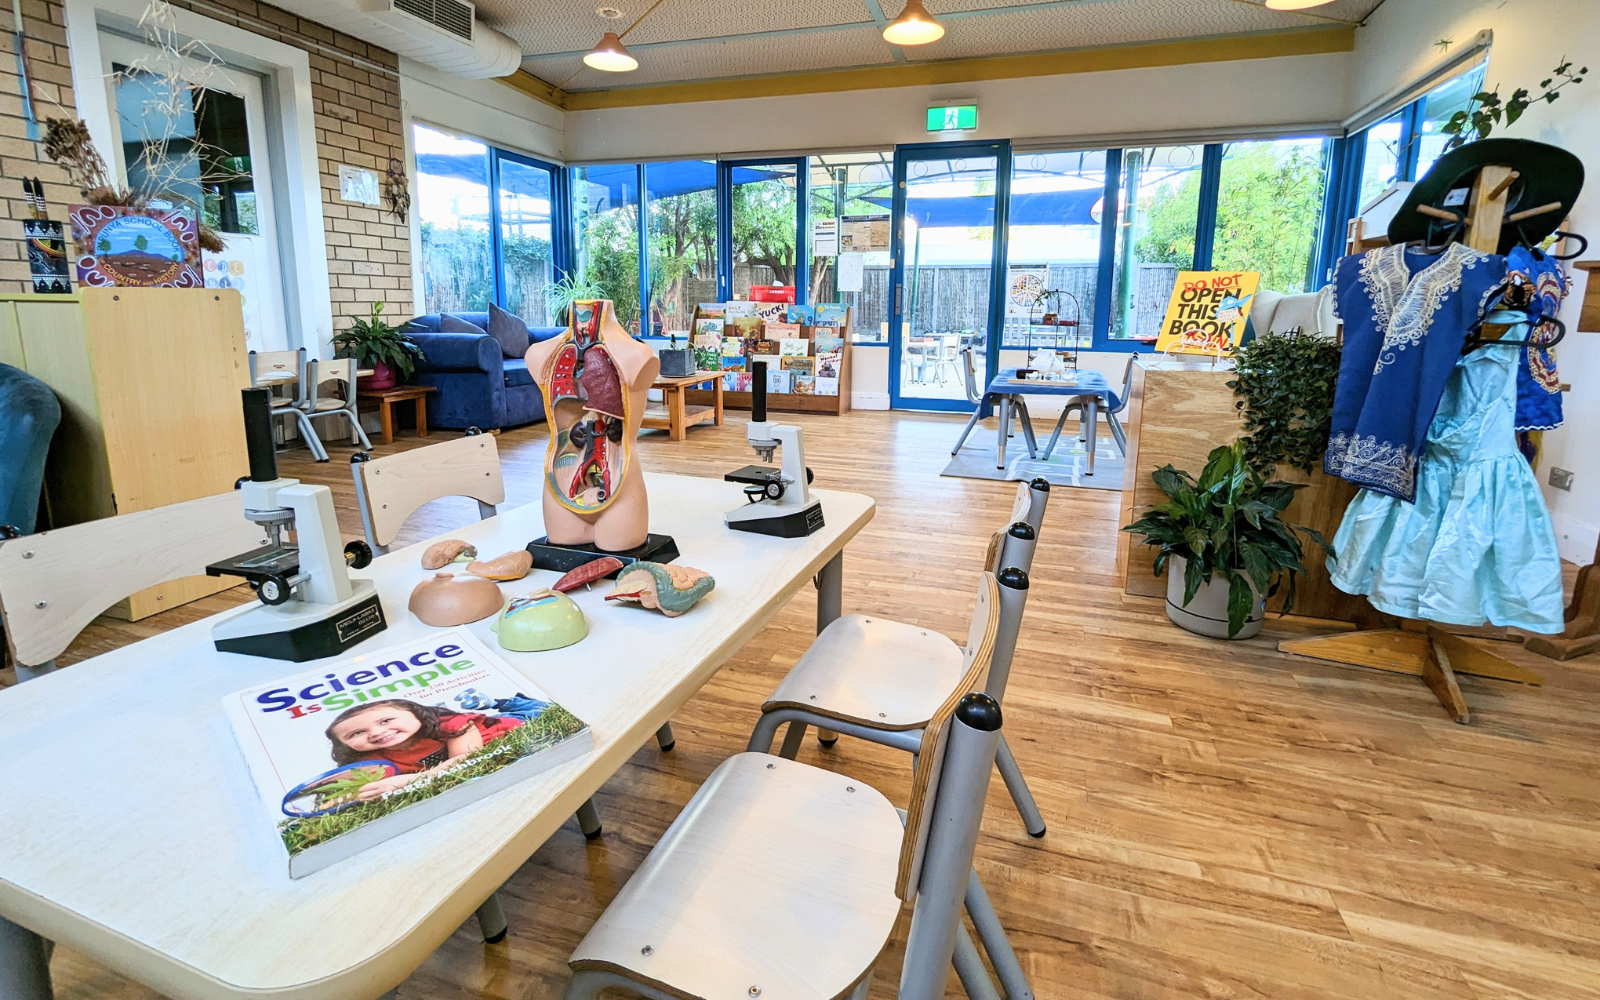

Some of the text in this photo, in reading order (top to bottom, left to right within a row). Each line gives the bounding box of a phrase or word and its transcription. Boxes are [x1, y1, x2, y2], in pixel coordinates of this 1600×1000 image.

[124, 217, 164, 232] SCHOOL
[164, 230, 181, 253] BOOK
[103, 263, 141, 286] COUNTRY
[153, 262, 179, 285] HISTORY
[1183, 274, 1243, 293] DO NOT
[1180, 288, 1242, 303] OPEN
[758, 303, 784, 318] YUCK!
[1178, 303, 1219, 320] THIS
[1169, 319, 1236, 338] BOOK
[257, 645, 464, 713] Science
[286, 660, 475, 719] Is Simple
[403, 669, 487, 698] Over 250 Activities
[435, 673, 491, 694] Preschoolers
[381, 744, 513, 800] Peggy Ashbrook
